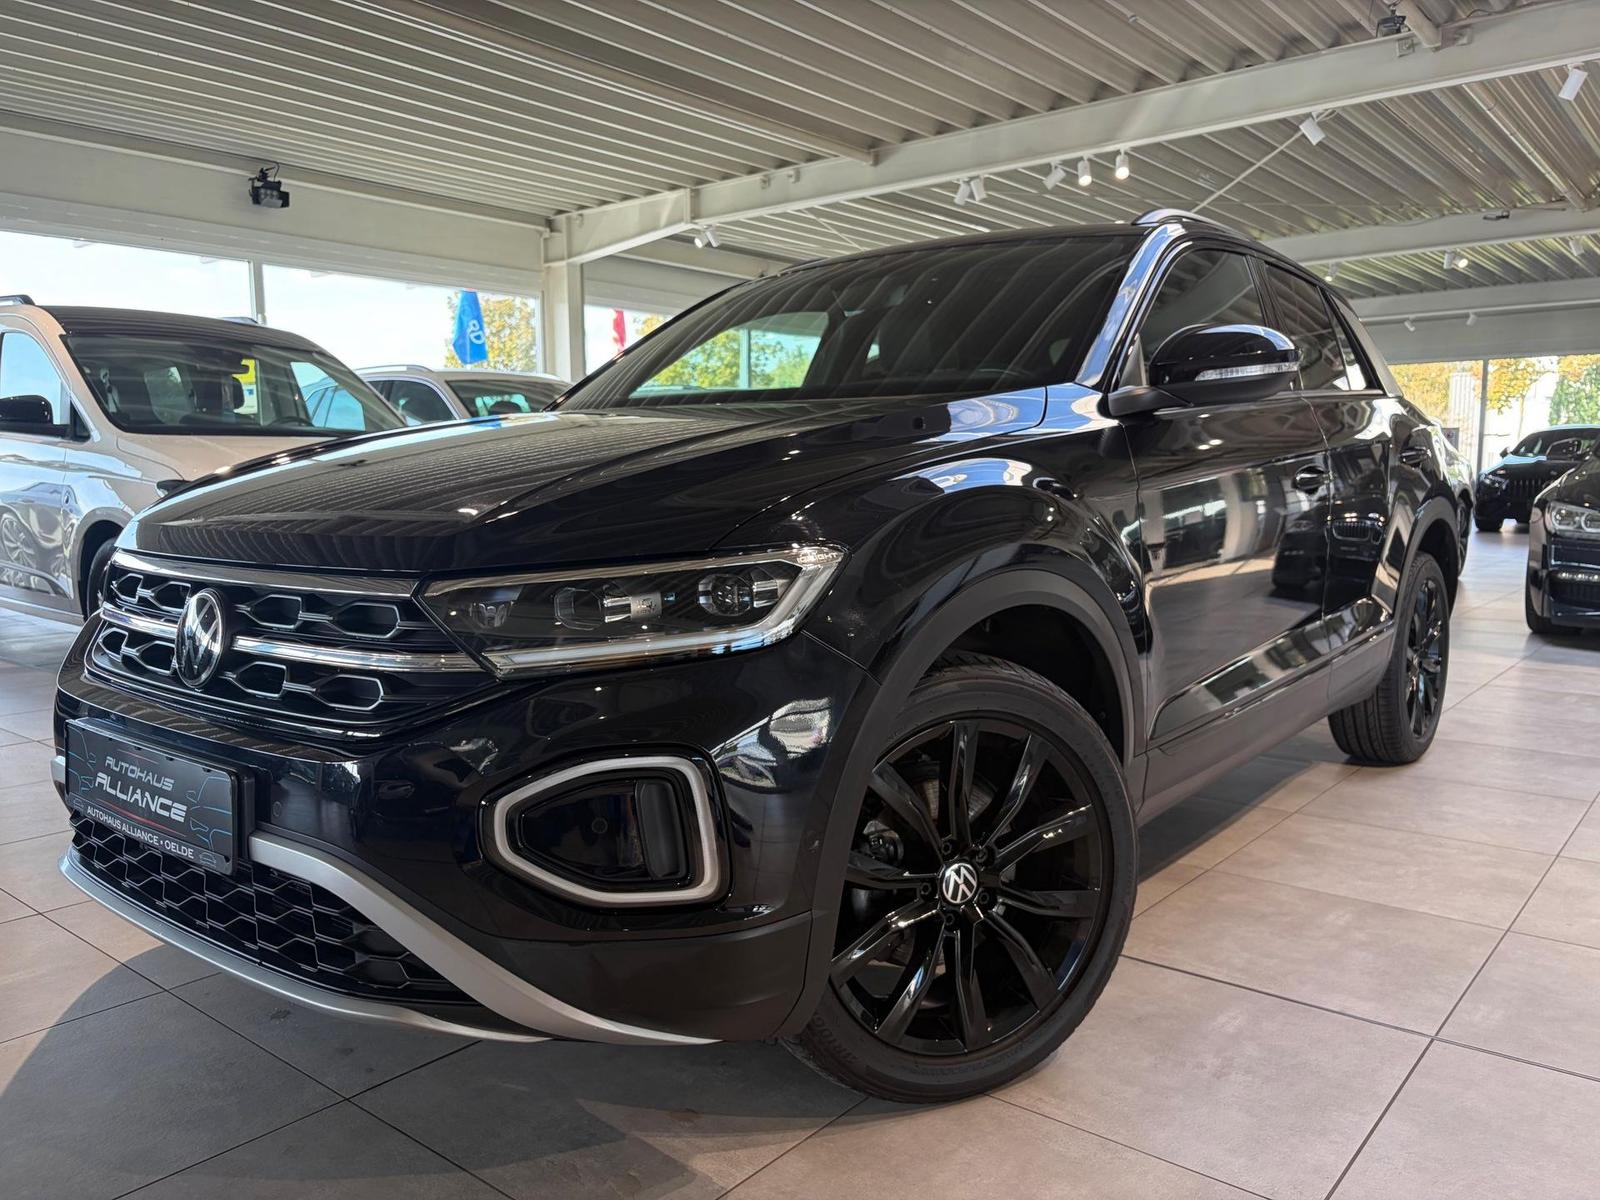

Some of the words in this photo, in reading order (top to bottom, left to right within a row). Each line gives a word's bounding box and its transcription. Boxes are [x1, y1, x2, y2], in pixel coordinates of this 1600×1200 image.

[95, 772, 187, 823] ALLIANCE
[105, 756, 175, 791] AUTOHAUS
[86, 805, 121, 829] AUTOHAUS
[121, 823, 159, 846] ALLIANCE
[164, 840, 194, 859] OELDE
